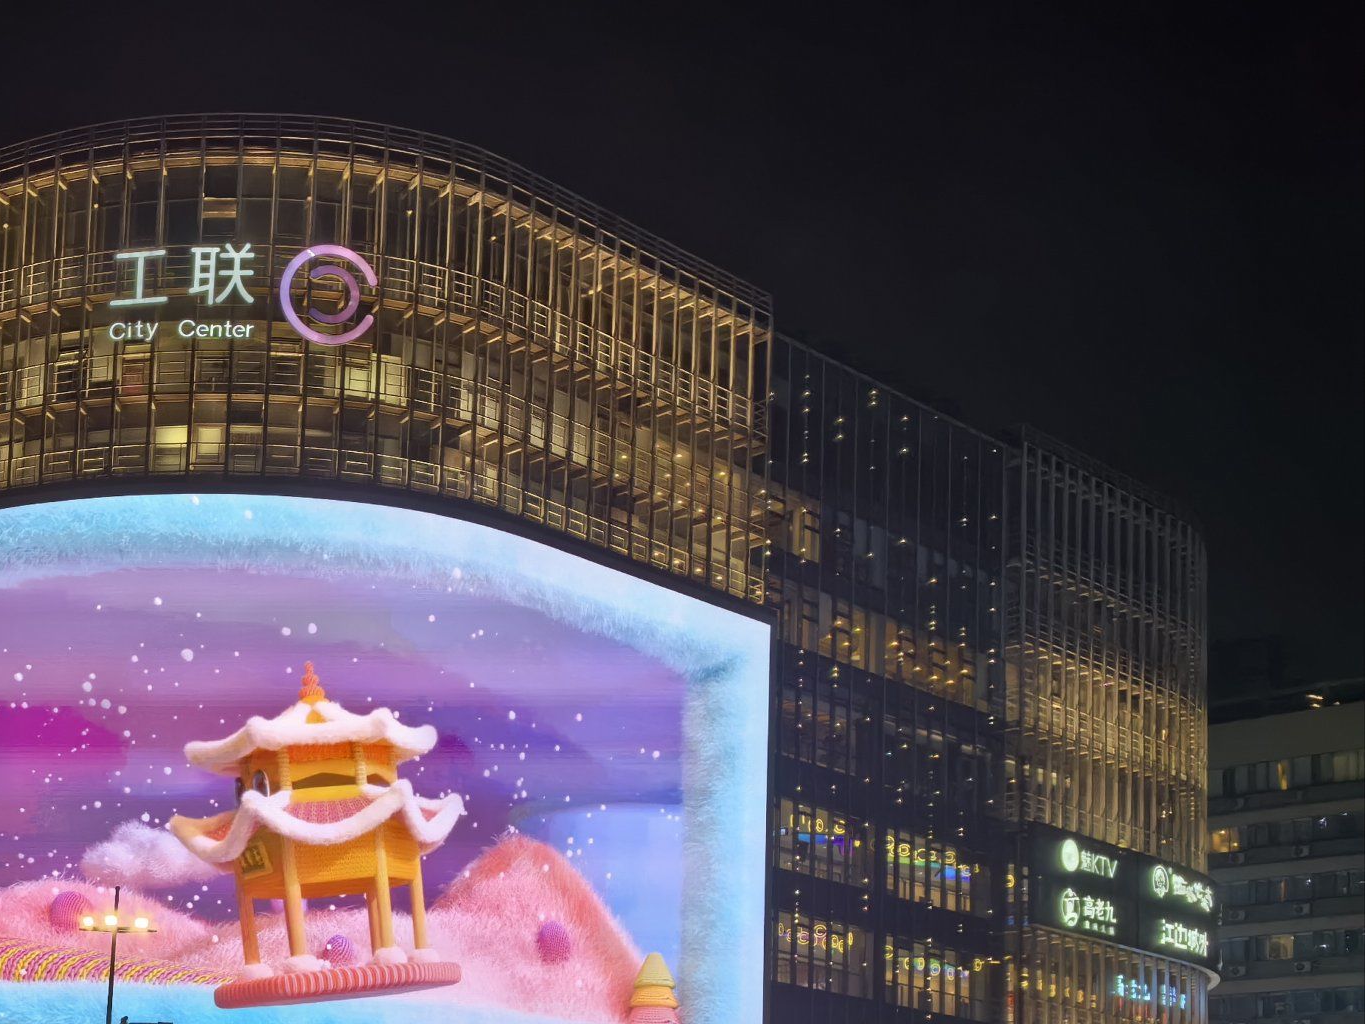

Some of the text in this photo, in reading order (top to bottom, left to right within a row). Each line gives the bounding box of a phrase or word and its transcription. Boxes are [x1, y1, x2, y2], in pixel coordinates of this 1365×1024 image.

[110, 242, 255, 307] 工联
[109, 319, 255, 342] City Center
